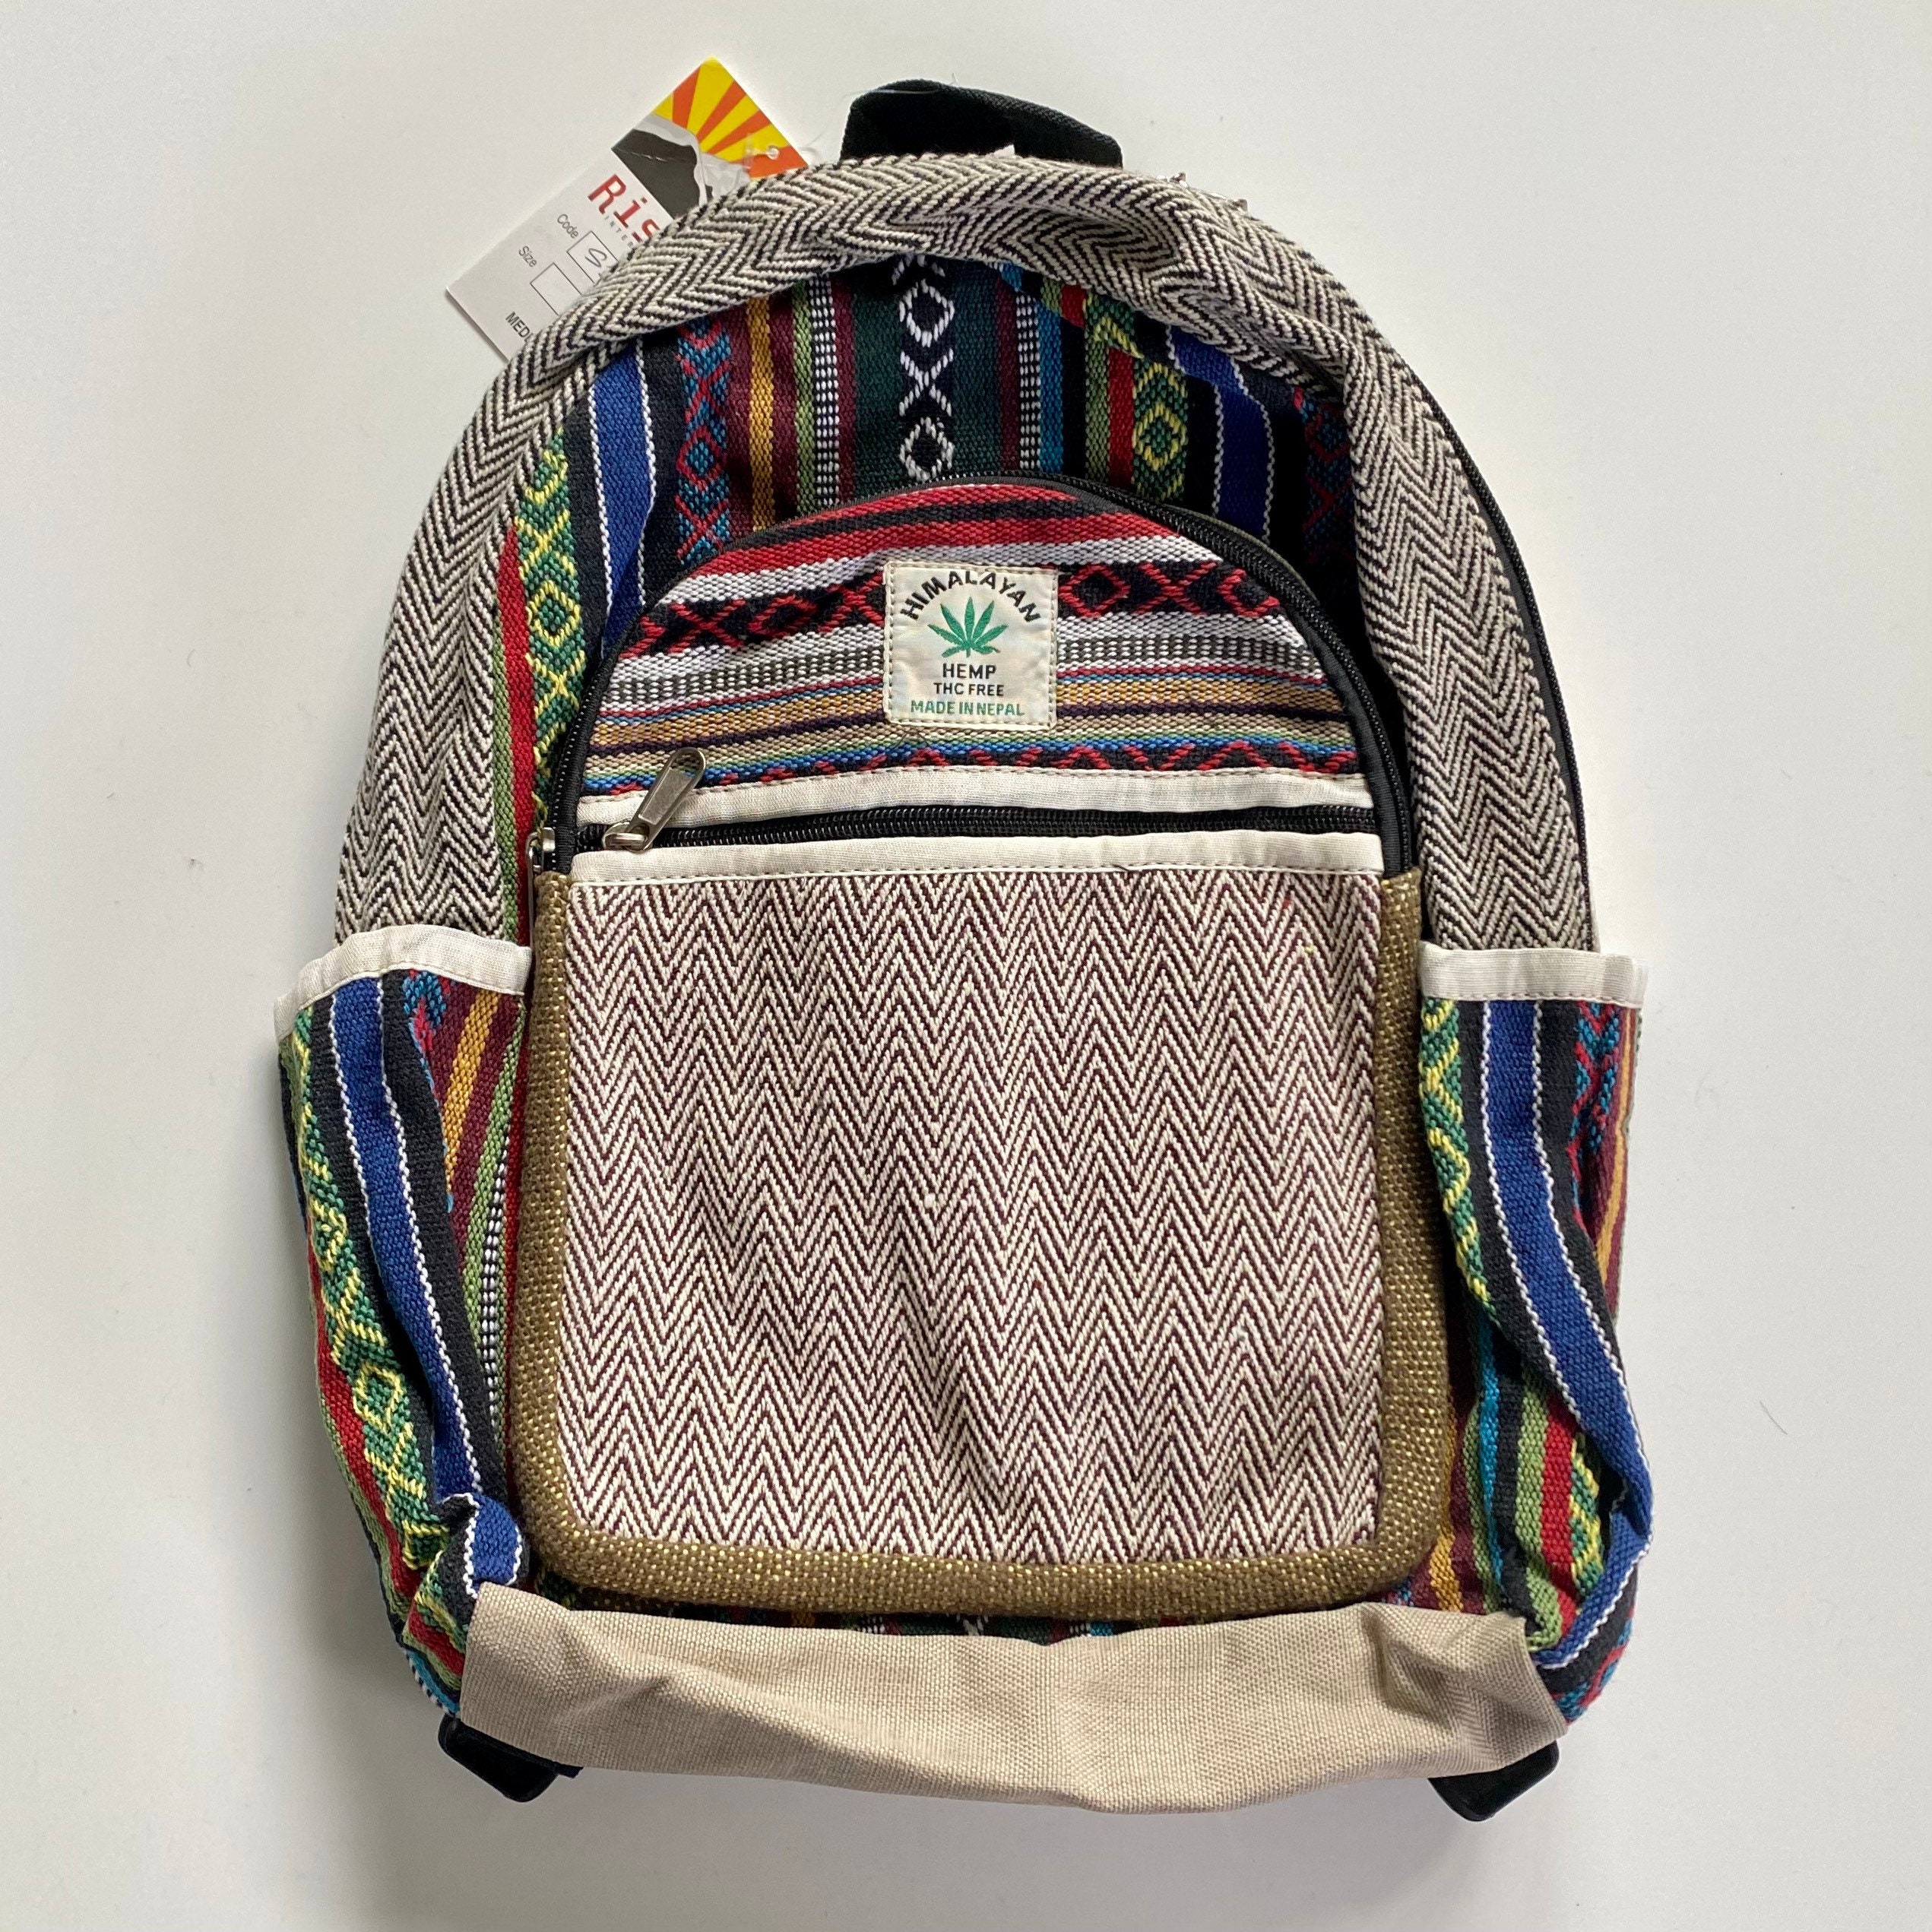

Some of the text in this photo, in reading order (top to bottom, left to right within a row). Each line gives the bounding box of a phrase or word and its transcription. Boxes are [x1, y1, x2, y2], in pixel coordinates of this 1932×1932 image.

[557, 214, 579, 239] Code
[518, 245, 537, 268] Size
[900, 570, 1041, 622] HIMALAYAN
[942, 662, 997, 679] HEMP
[933, 682, 1005, 697] THC FREE
[911, 700, 1025, 717] MADE IN NEPAL
